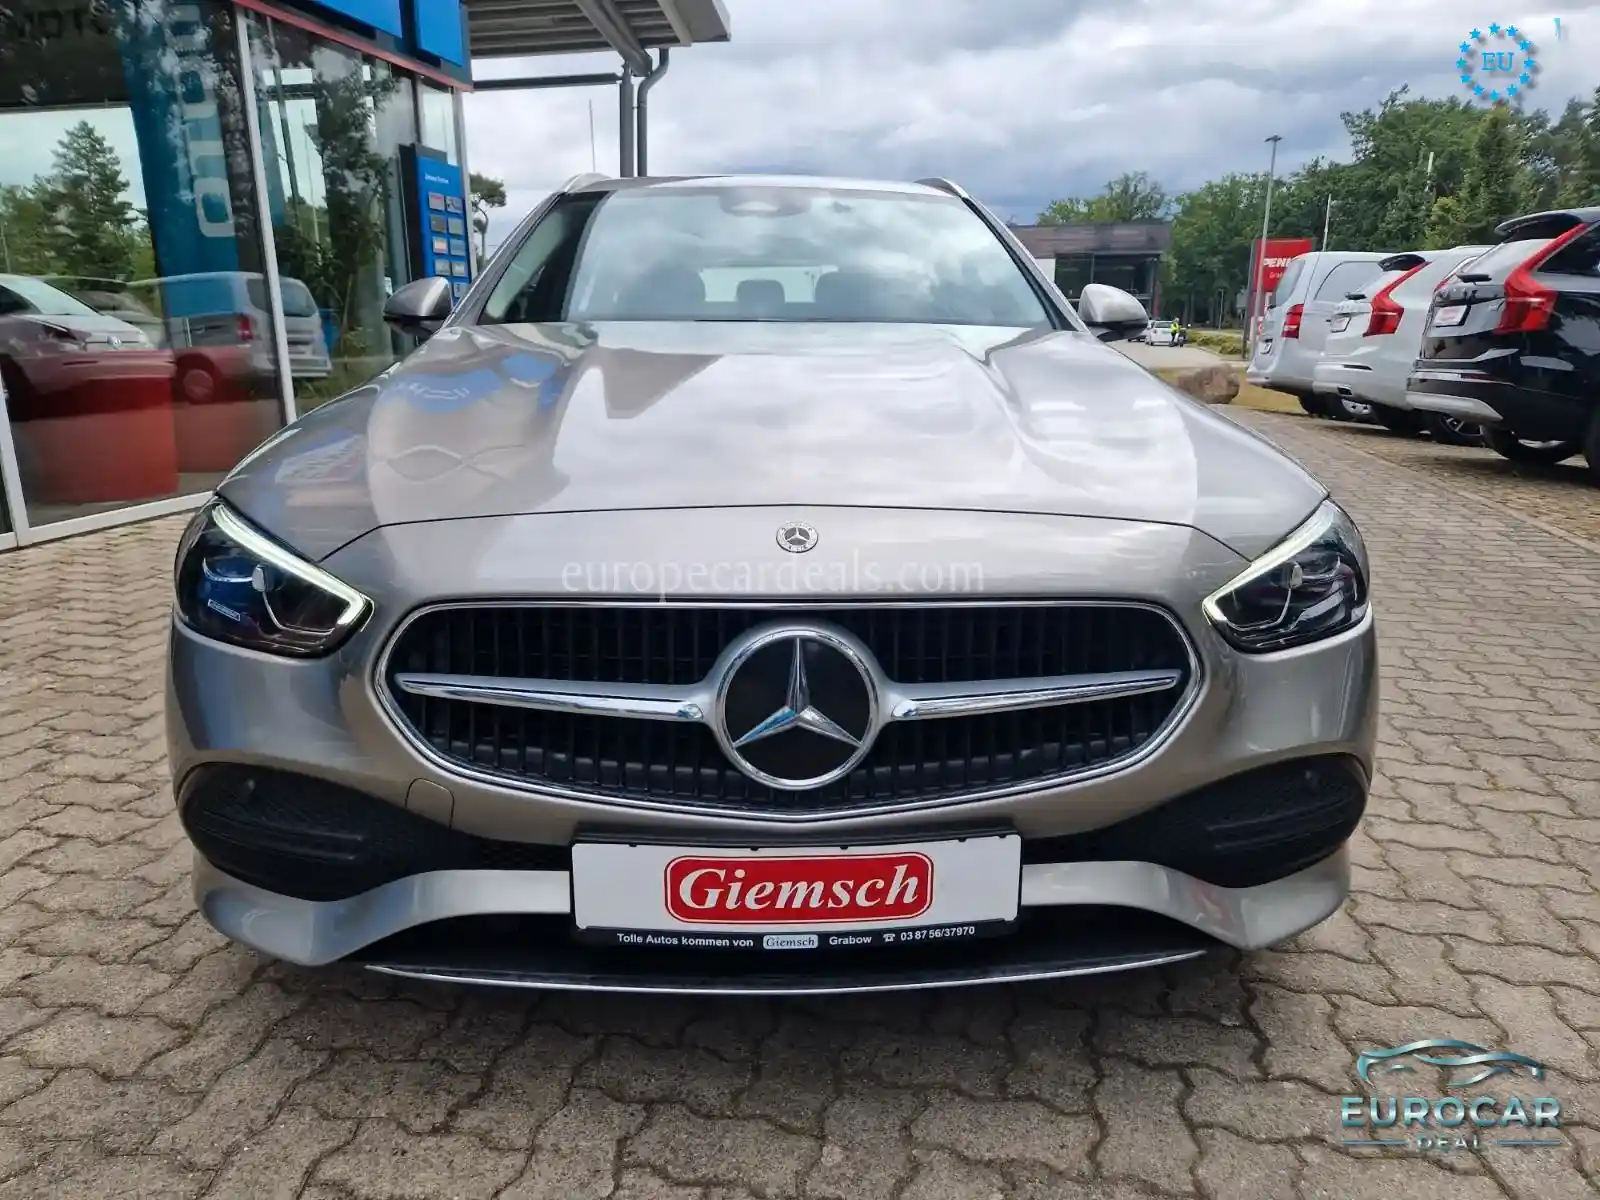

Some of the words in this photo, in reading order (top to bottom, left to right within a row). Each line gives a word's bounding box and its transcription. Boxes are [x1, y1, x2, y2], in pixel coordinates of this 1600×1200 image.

[679, 863, 919, 910] Giemsch
[617, 932, 643, 943] Tolle
[646, 934, 678, 945] Autos
[682, 936, 729, 947] kommen
[732, 939, 753, 948] von
[766, 936, 815, 948] Giemsch
[829, 935, 872, 946] Grabow
